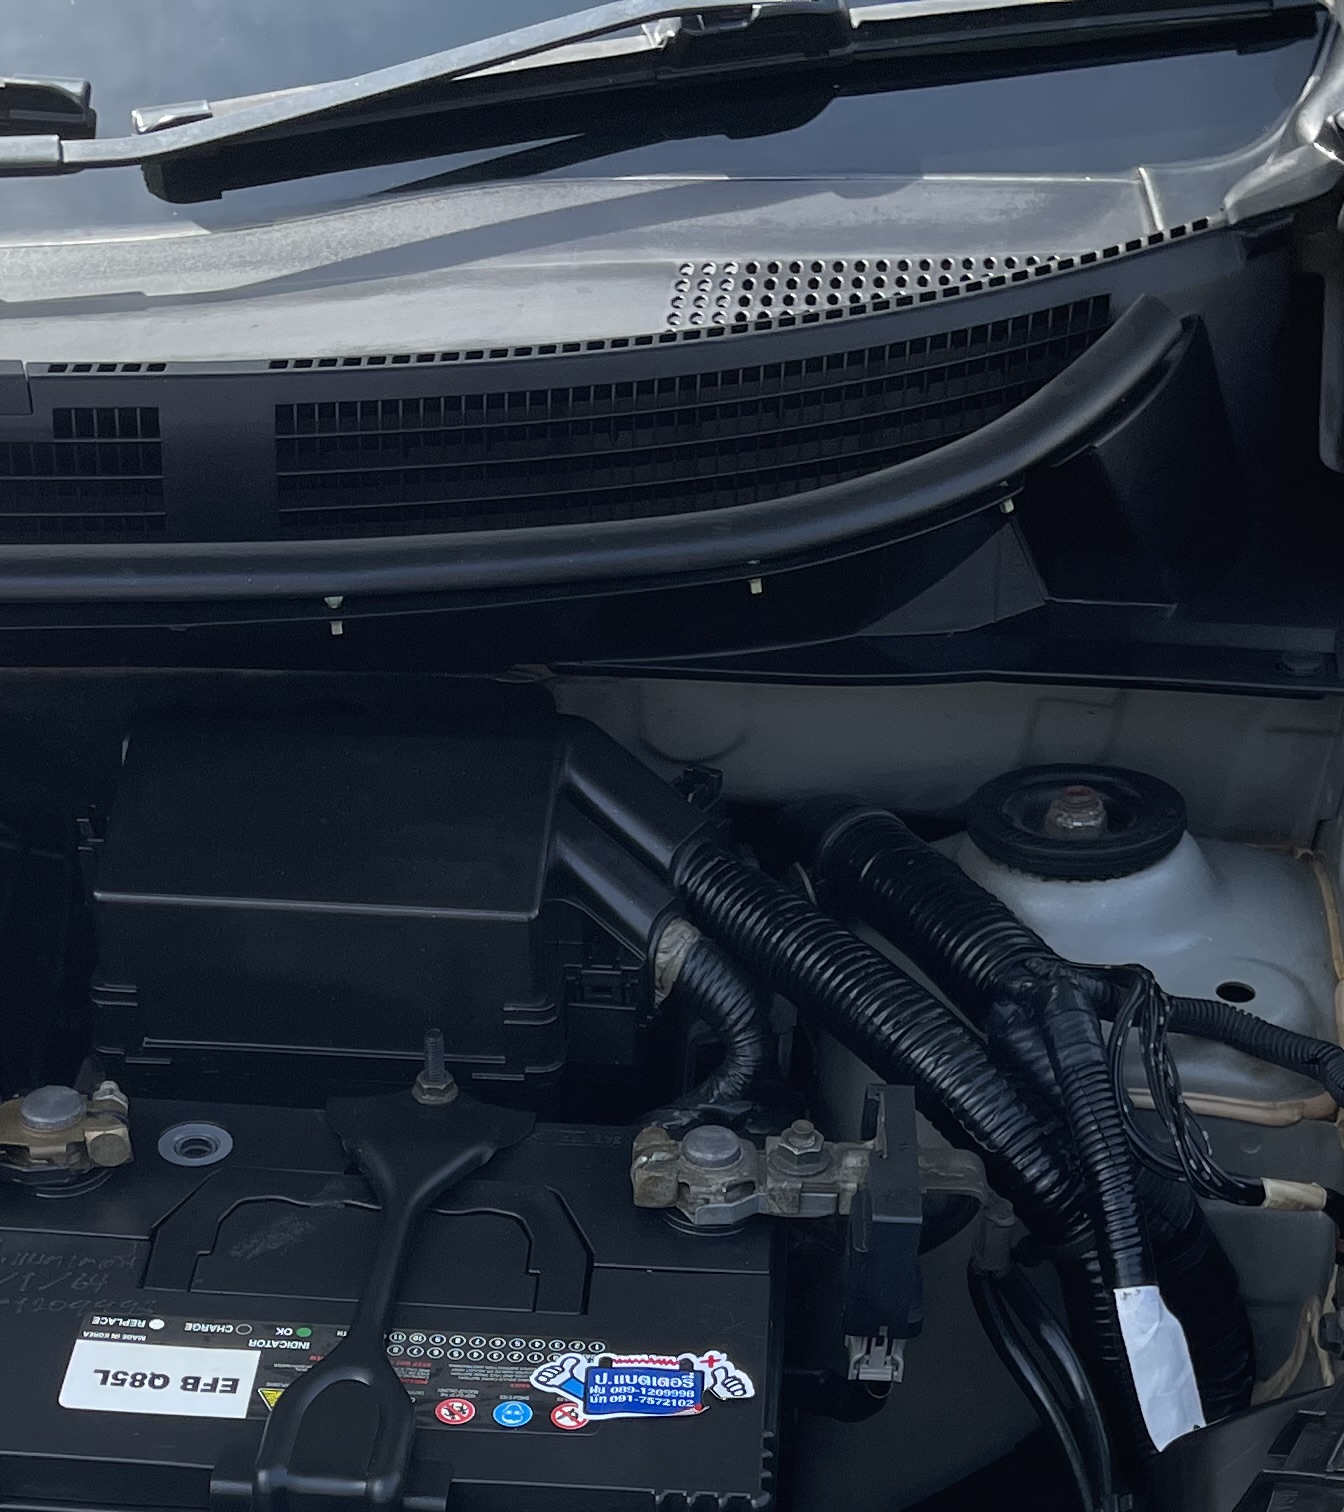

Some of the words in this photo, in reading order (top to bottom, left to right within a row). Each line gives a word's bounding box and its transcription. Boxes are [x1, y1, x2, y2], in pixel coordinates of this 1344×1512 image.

[91, 1316, 147, 1328] REPLACE
[184, 1322, 234, 1334] CHARGE
[83, 1330, 110, 1340] KOREA
[275, 1326, 293, 1336] OK
[121, 1333, 147, 1342] MADE
[248, 1338, 311, 1350] INDICATOR
[93, 1368, 170, 1391] Q85L
[179, 1376, 240, 1395] EFB
